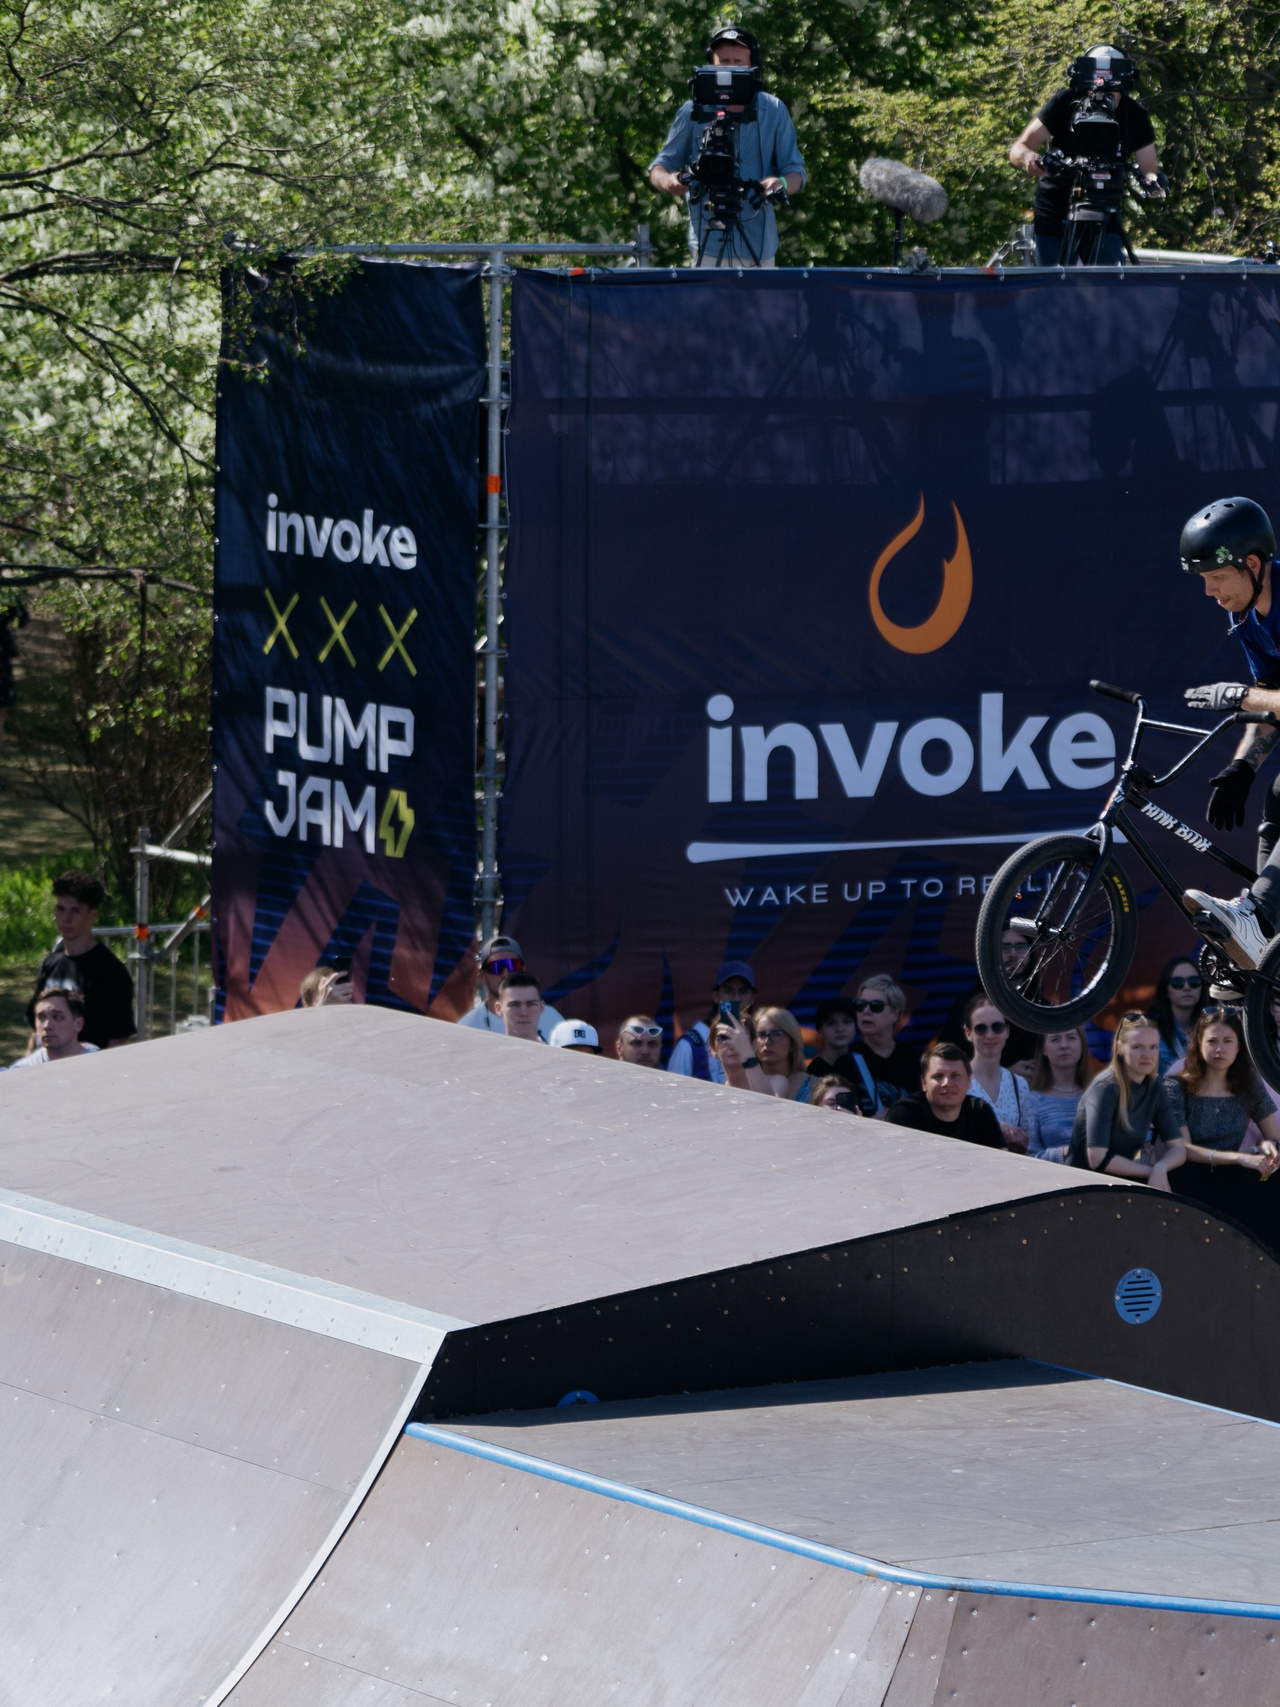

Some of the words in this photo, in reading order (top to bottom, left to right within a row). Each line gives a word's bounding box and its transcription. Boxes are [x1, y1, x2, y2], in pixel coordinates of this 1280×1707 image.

[266, 493, 418, 570] invoke
[265, 686, 415, 774] PUMP
[706, 692, 1117, 803] invoke
[265, 770, 377, 855] JAM
[724, 884, 830, 908] WAKE
[843, 880, 887, 902] UP
[900, 878, 944, 899] TO
[1112, 875, 1130, 913] MAXXIS
